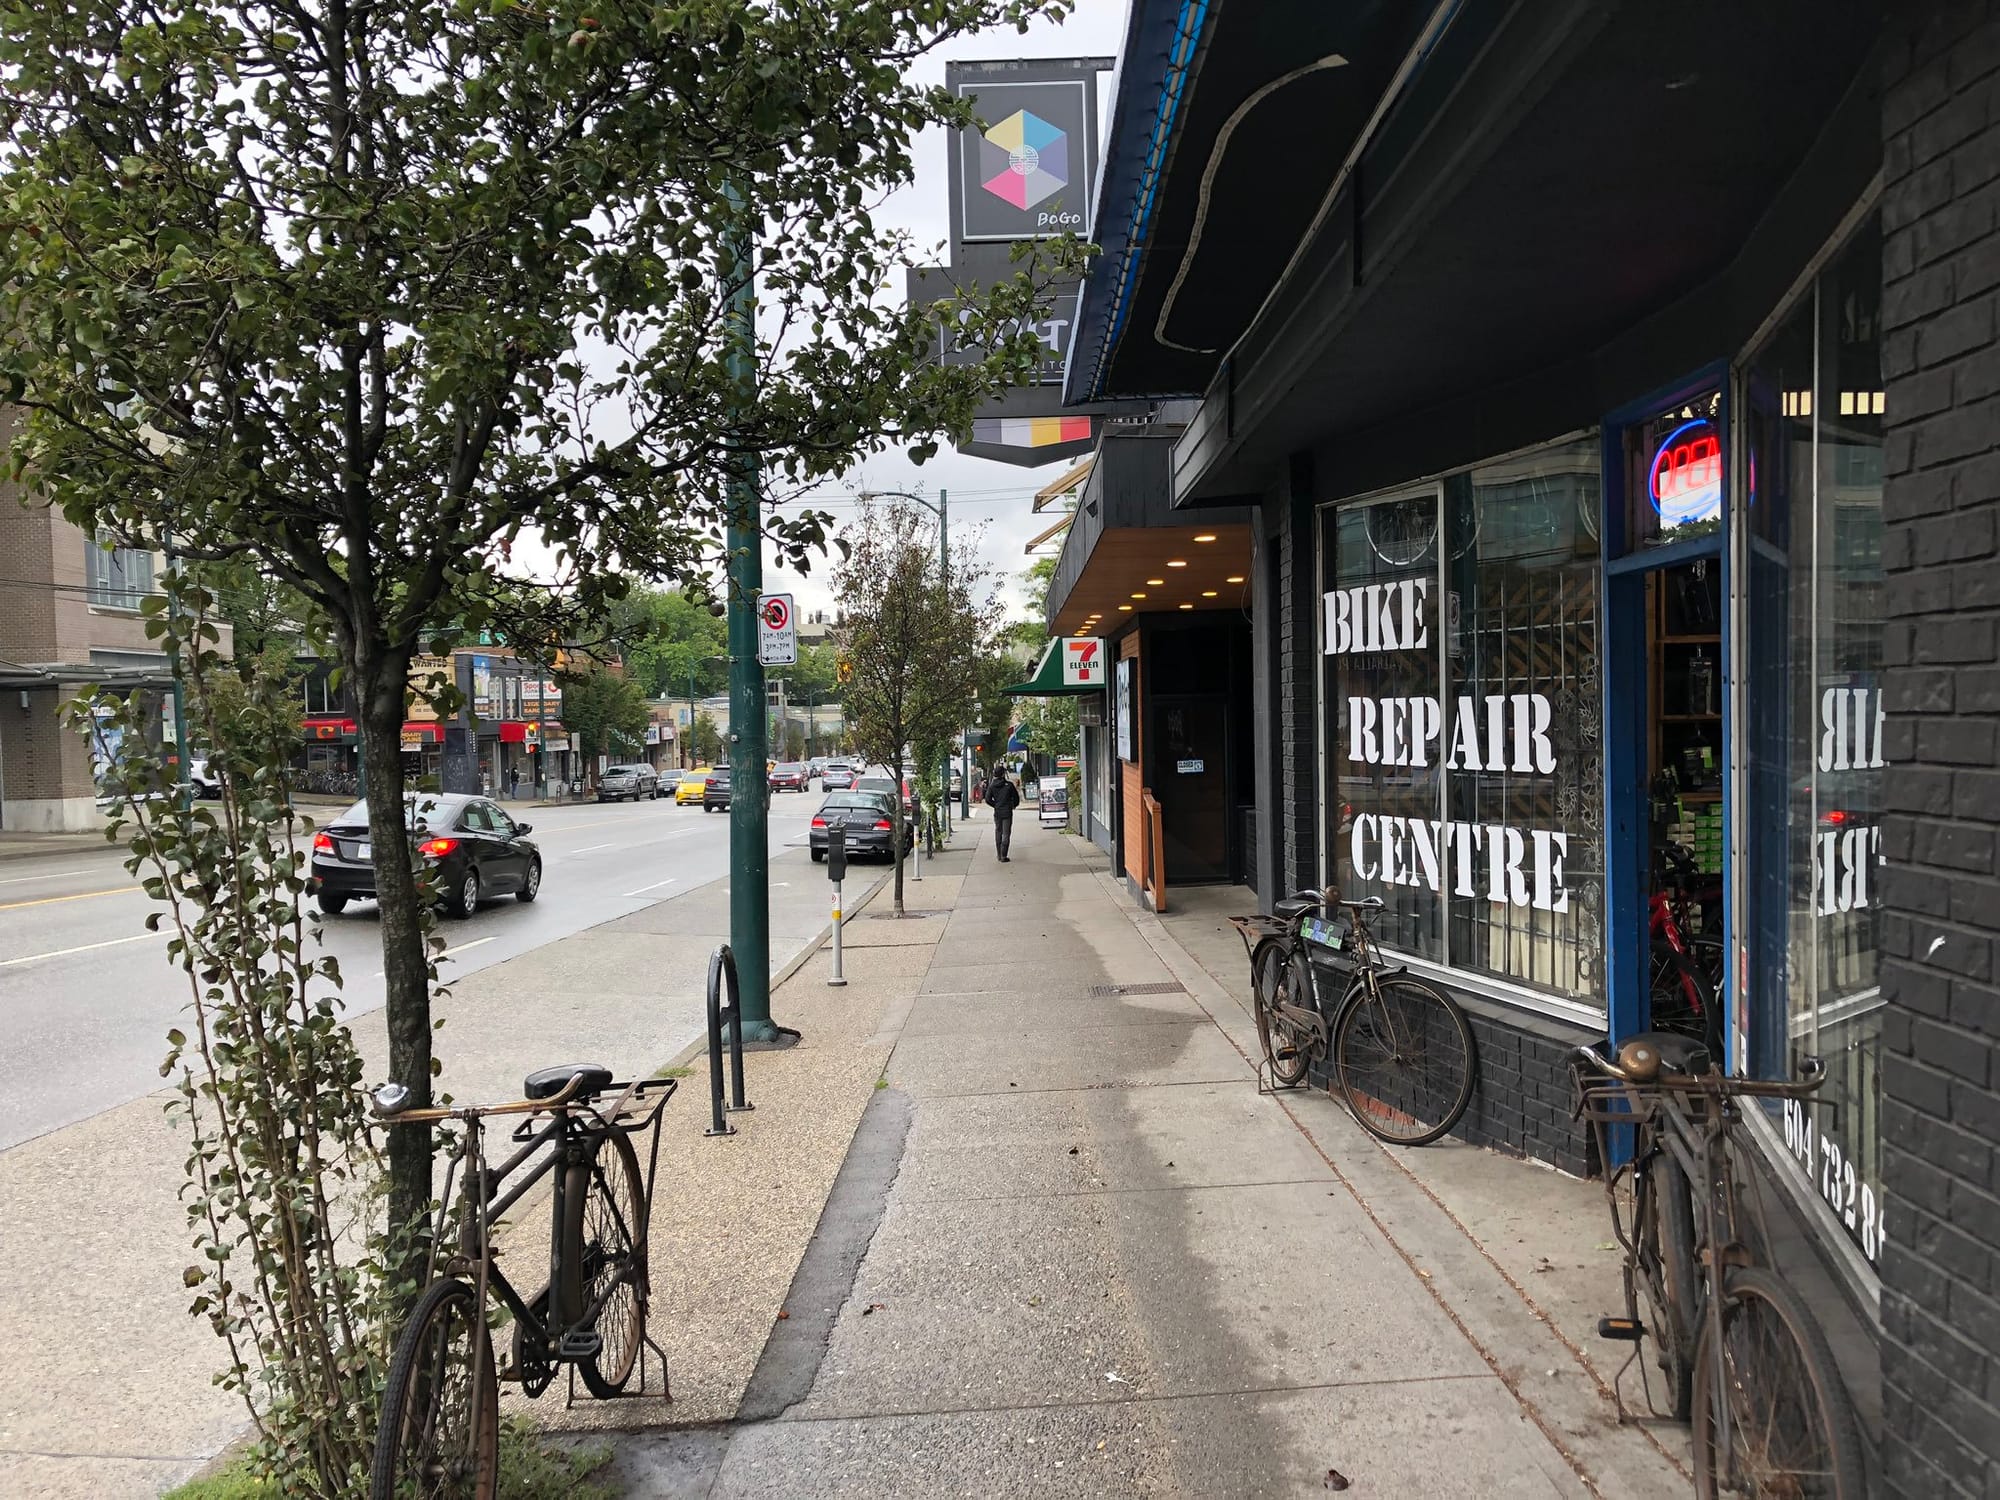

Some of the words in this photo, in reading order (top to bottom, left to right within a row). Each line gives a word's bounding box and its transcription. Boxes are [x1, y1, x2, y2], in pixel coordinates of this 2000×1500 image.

[1652, 435, 1722, 499] OPEN
[1323, 578, 1428, 656] BIKE
[1069, 641, 1098, 680] 7
[1348, 693, 1558, 775] REPAIR
[1351, 812, 1569, 914] CENTRE
[1784, 1098, 1813, 1180] 604
[1821, 1134, 1856, 1230] 732
